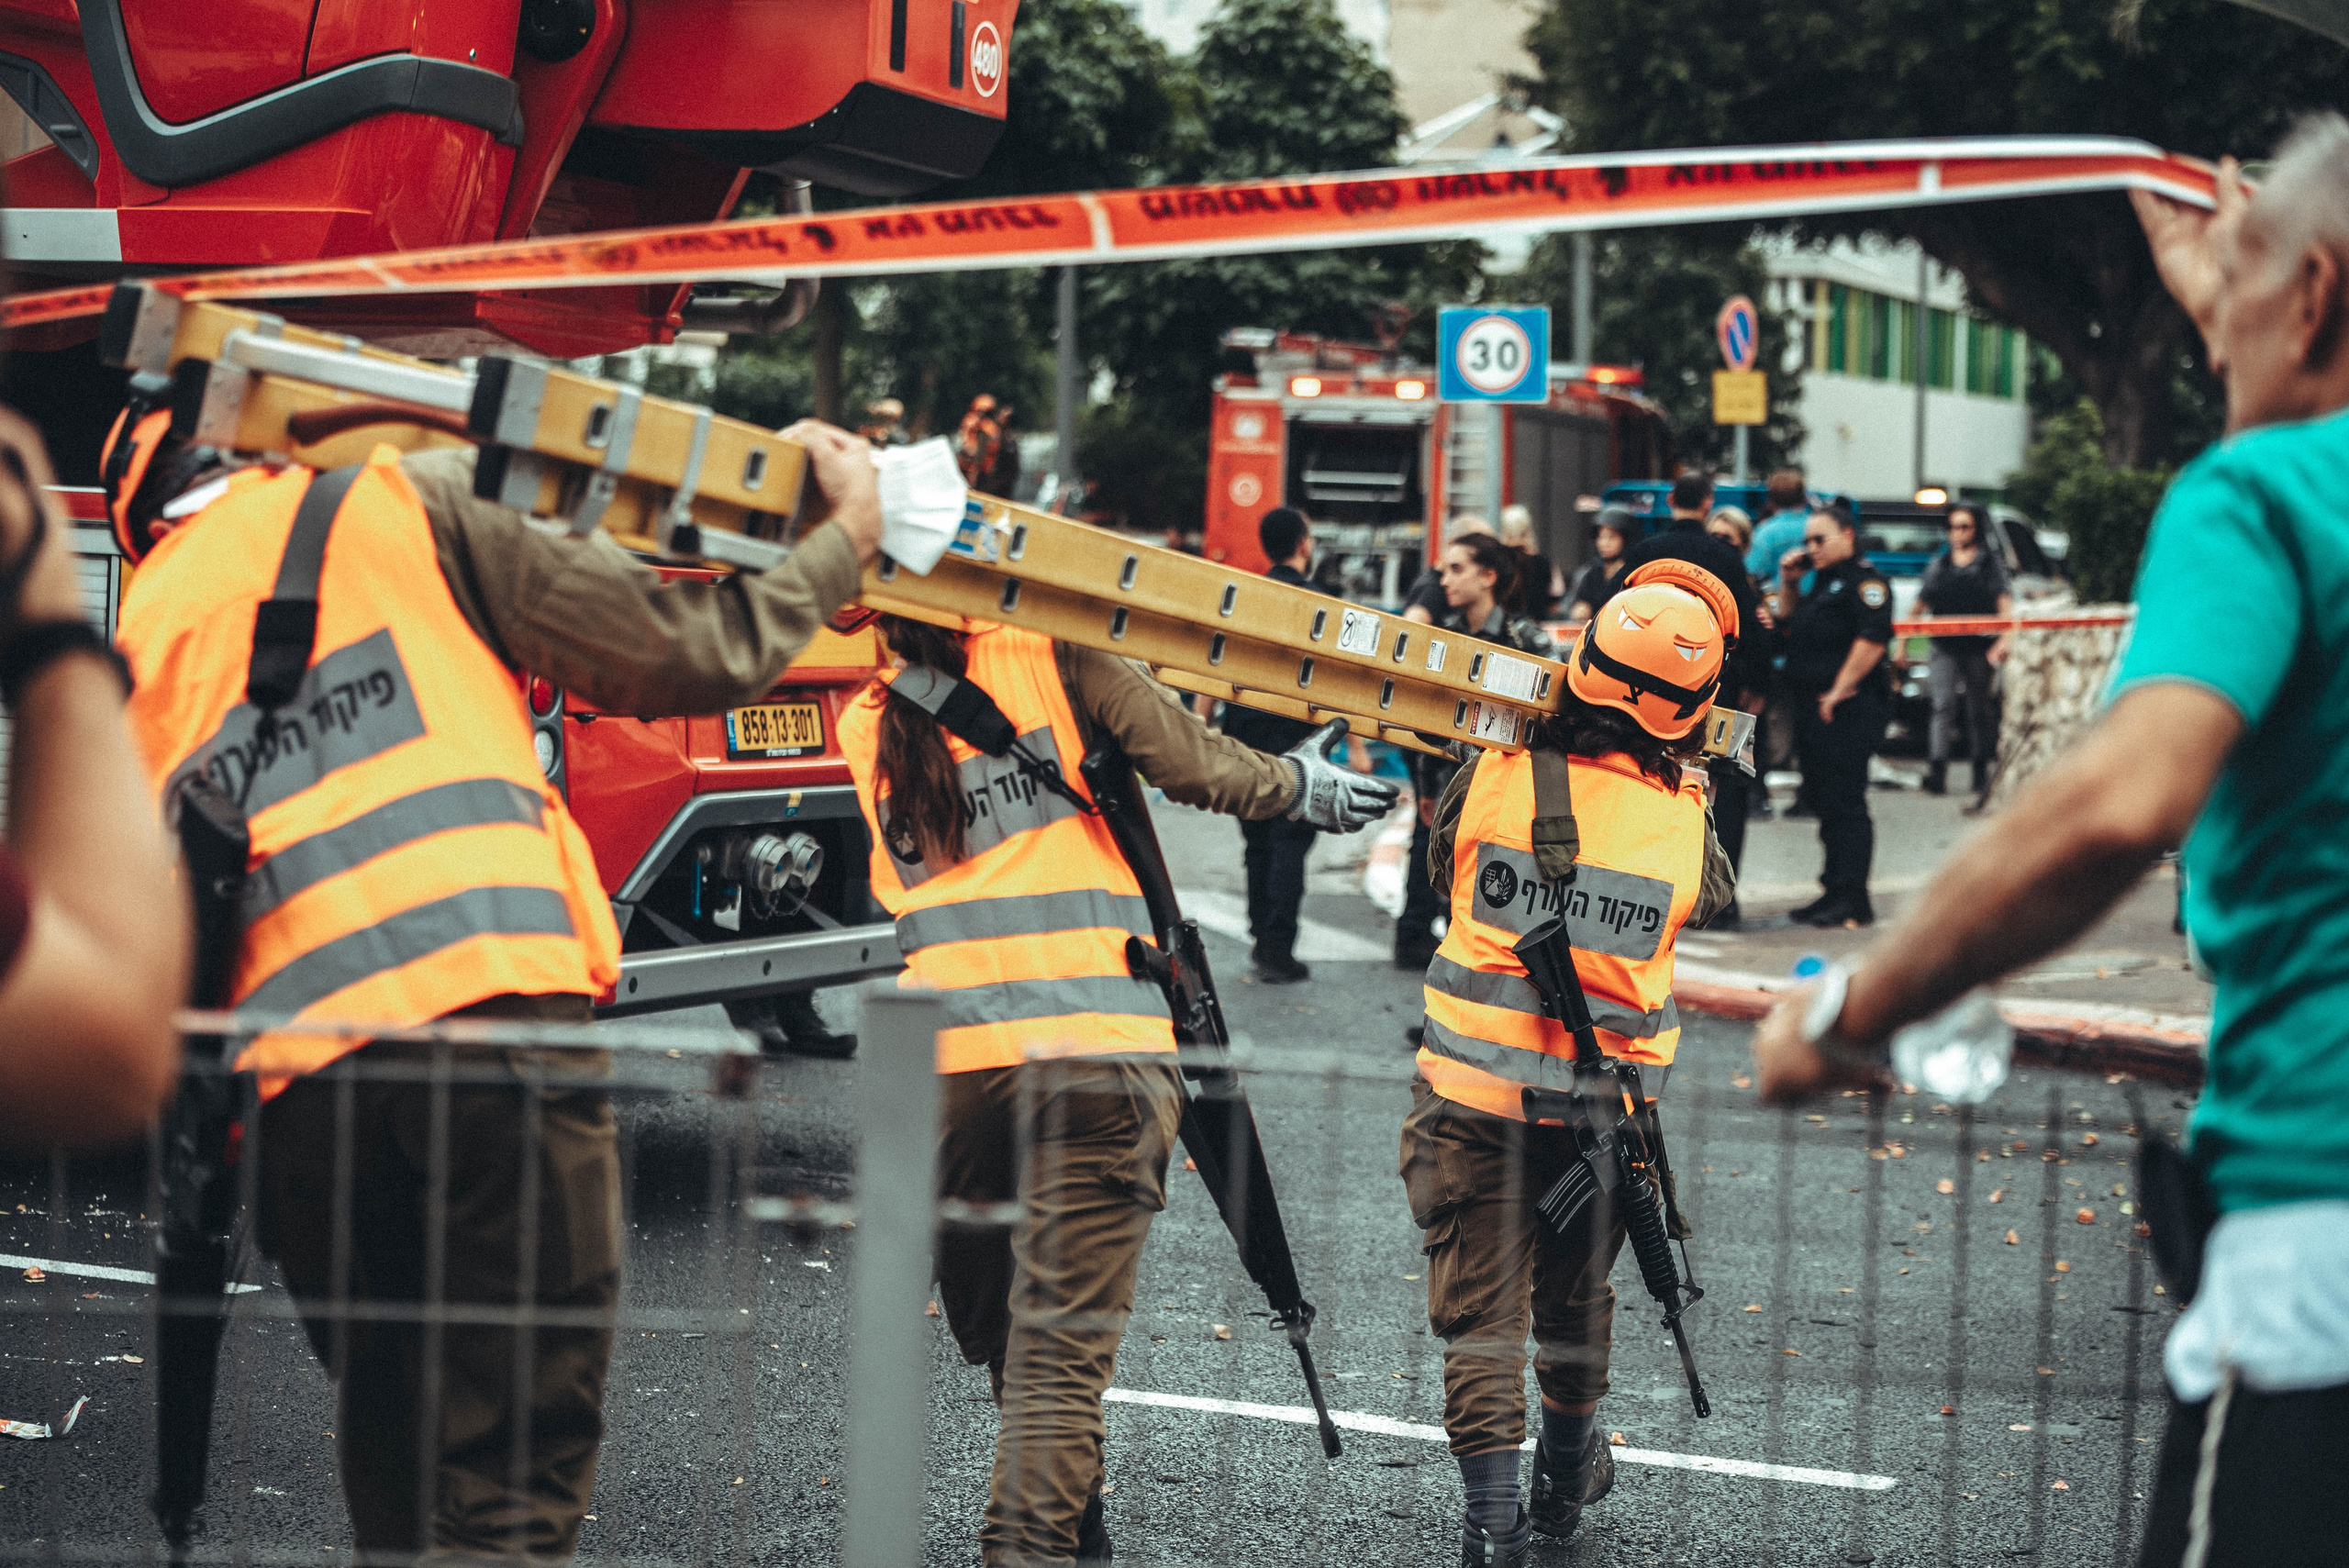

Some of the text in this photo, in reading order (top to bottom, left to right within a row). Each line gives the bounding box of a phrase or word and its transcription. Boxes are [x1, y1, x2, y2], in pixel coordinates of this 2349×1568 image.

[974, 39, 998, 80] 480
[1470, 338, 1520, 373] 30
[307, 669, 398, 735] פיקוד
[1521, 879, 1660, 935] פיקוד העורף
